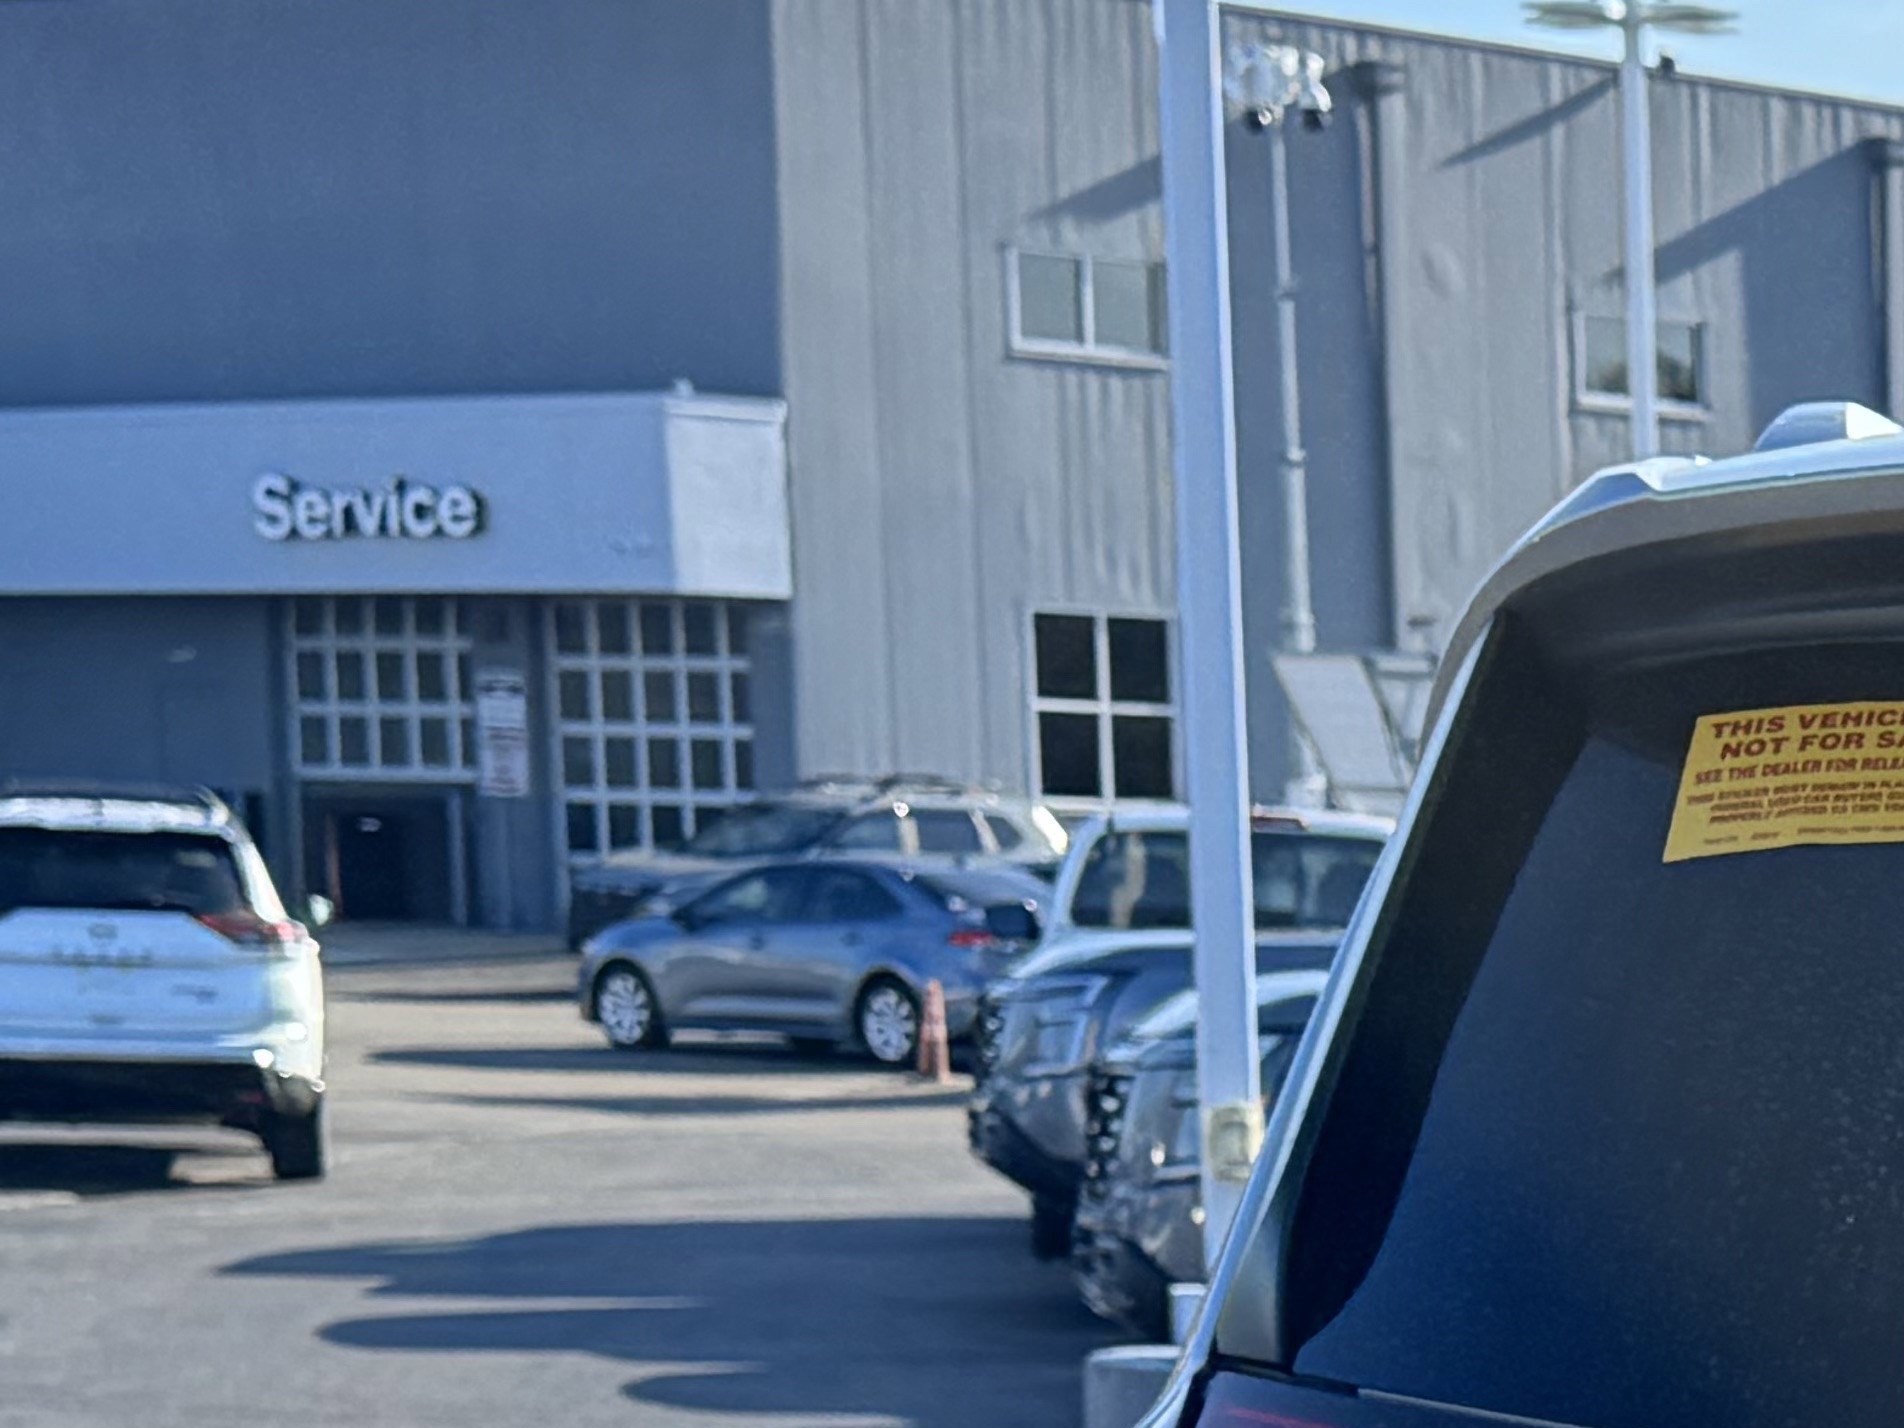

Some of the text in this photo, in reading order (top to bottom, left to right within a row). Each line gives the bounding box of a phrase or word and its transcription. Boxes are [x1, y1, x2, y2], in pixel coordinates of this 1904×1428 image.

[252, 473, 490, 541] Service
[1711, 714, 1786, 739] THIS
[1720, 736, 1790, 761] NOT
[1797, 732, 1865, 753] FOR
[1728, 765, 1758, 781] THE
[1761, 760, 1823, 778] DEALER
[1825, 757, 1858, 773] FOR
